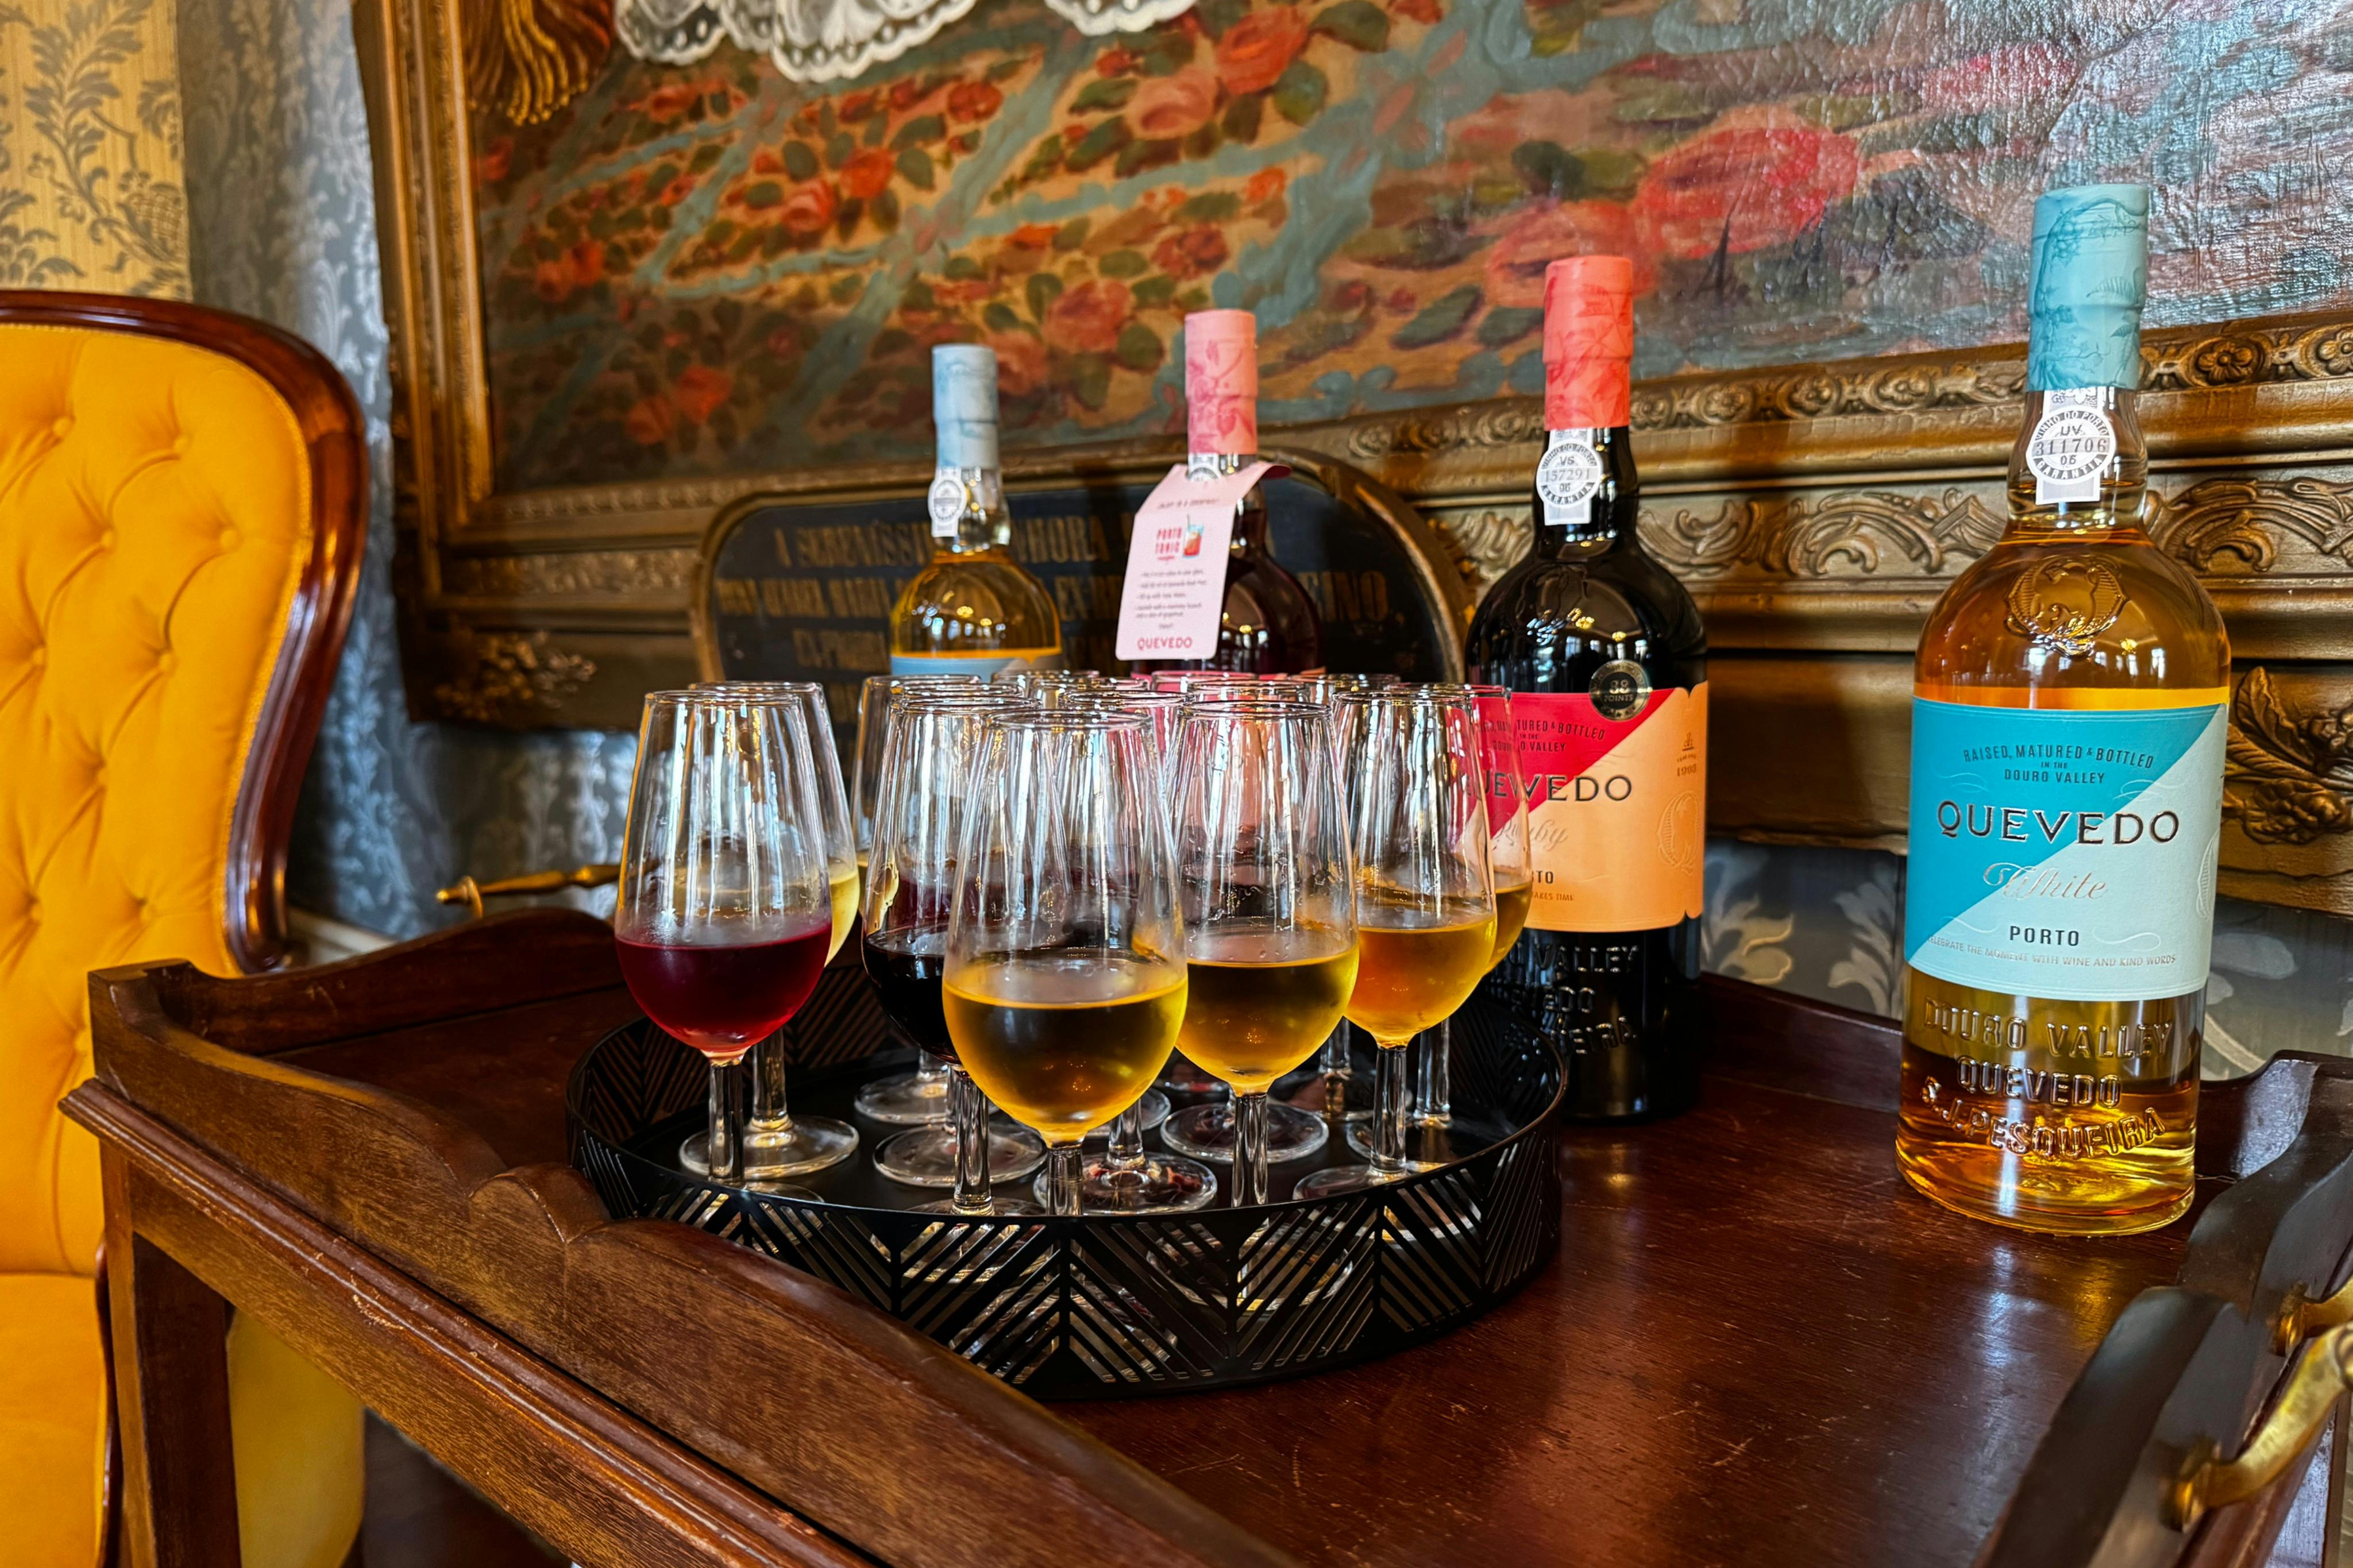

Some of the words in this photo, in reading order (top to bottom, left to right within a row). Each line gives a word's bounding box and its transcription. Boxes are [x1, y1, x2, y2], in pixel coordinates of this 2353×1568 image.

[2035, 416, 2060, 440] VINHO
[2063, 411, 2078, 420] DO
[2081, 412, 2110, 435] PORTO
[2061, 425, 2082, 436] UV
[2036, 438, 2107, 456] 311706
[2036, 457, 2103, 479] GARANTIA
[1137, 636, 1193, 651] QUEVEDO
[1557, 723, 1606, 740] BOTTLED
[1530, 741, 1567, 752] VALLEY
[2015, 744, 2082, 759] MATURED
[2086, 748, 2093, 756] &
[2096, 748, 2155, 769] BOTTLED
[2004, 768, 2050, 782] DOURO
[2055, 772, 2105, 784] VALLEY
[1937, 800, 2180, 845] QUEVEDO
[1983, 862, 2109, 901] White
[1533, 892, 1553, 901] AKES
[2009, 925, 2080, 947] PORTO
[1966, 945, 1982, 955] THE
[2032, 956, 2059, 965] WITH
[2062, 956, 2090, 967] WINE
[2093, 957, 2116, 967] AND
[2120, 956, 2143, 967] KIND
[2146, 953, 2176, 965] WORDS
[1923, 997, 2027, 1050] DOURO
[2045, 1021, 2173, 1059] VALLEY
[1957, 1056, 2123, 1107] QUEVEDO
